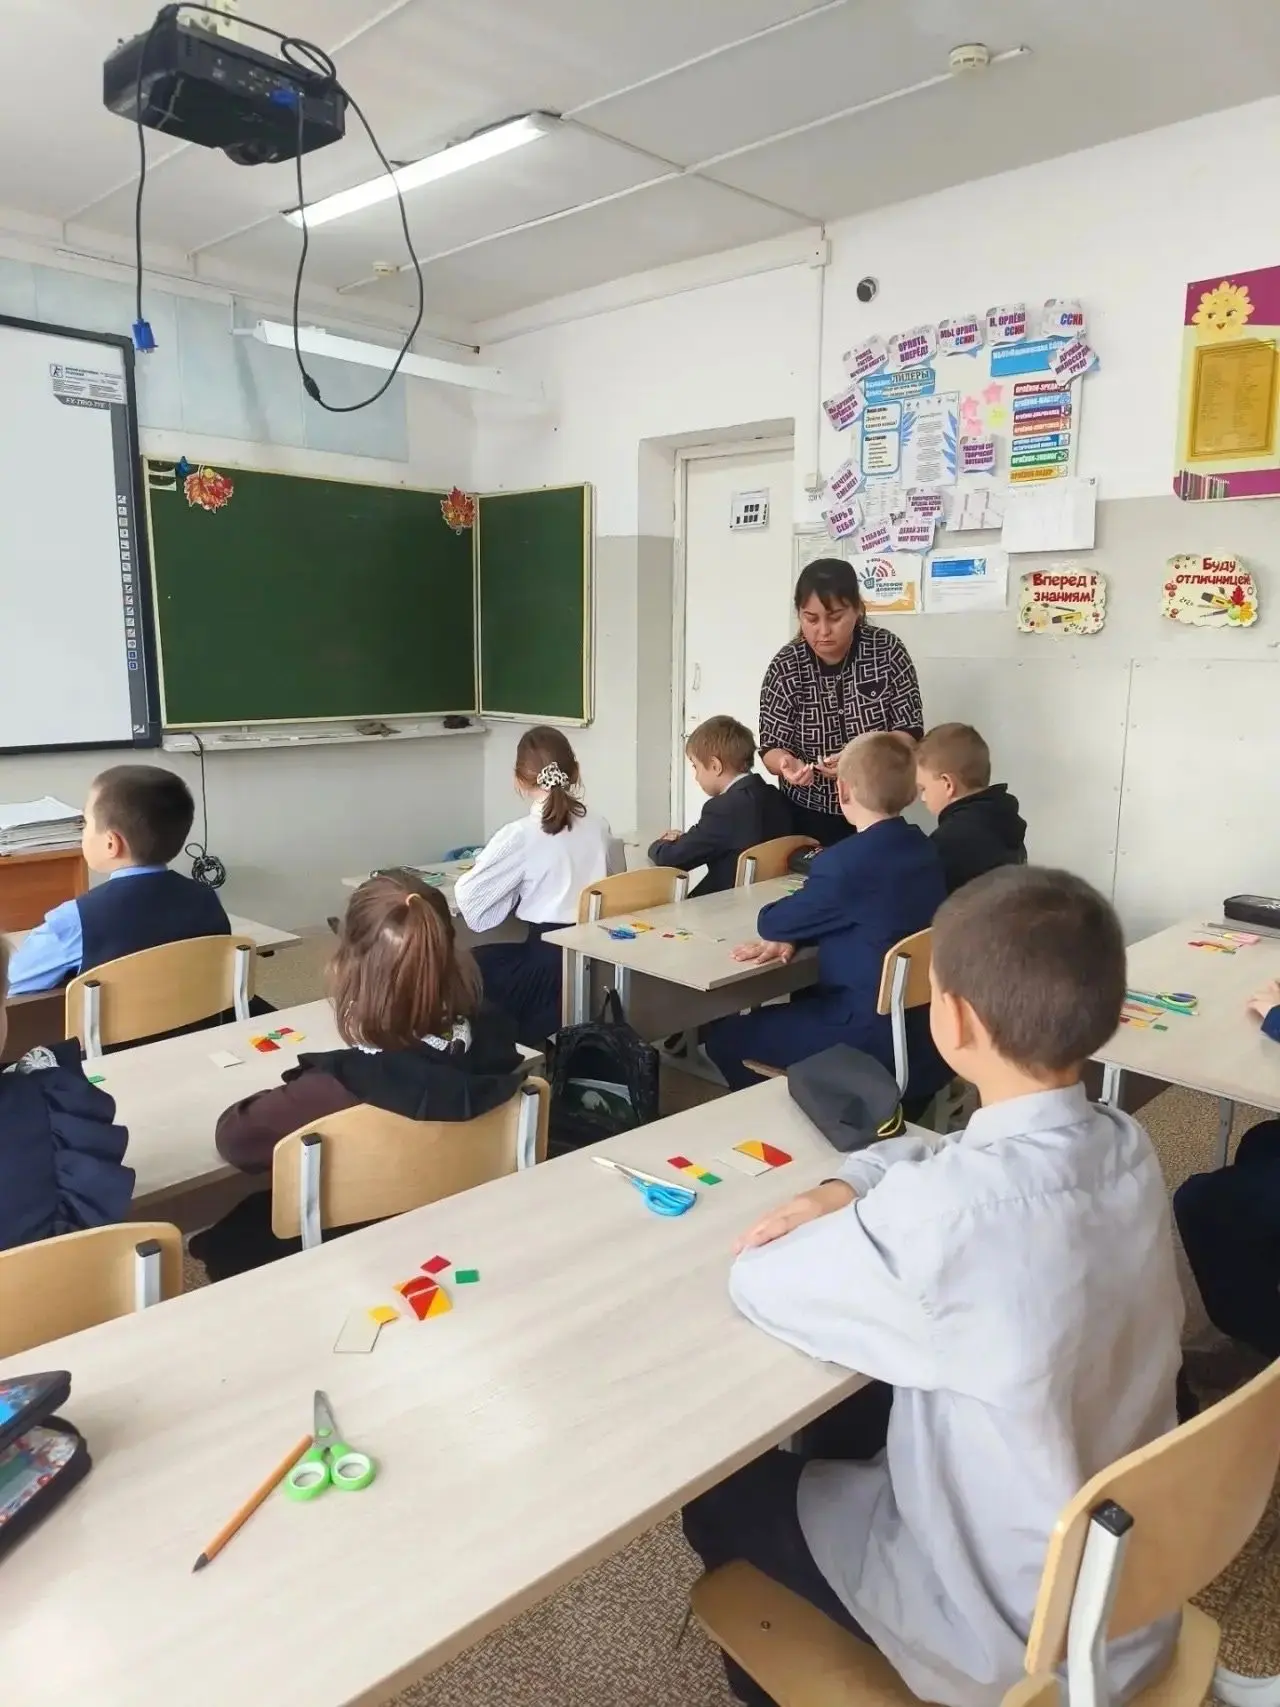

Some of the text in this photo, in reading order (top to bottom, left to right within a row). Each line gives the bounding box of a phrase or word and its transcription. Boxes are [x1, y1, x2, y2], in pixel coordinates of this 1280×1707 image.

[1202, 557, 1236, 573] Буду
[1032, 573, 1098, 590] Вперед к
[1175, 574, 1252, 586] отличницей!
[1033, 588, 1096, 603] знаниям!
